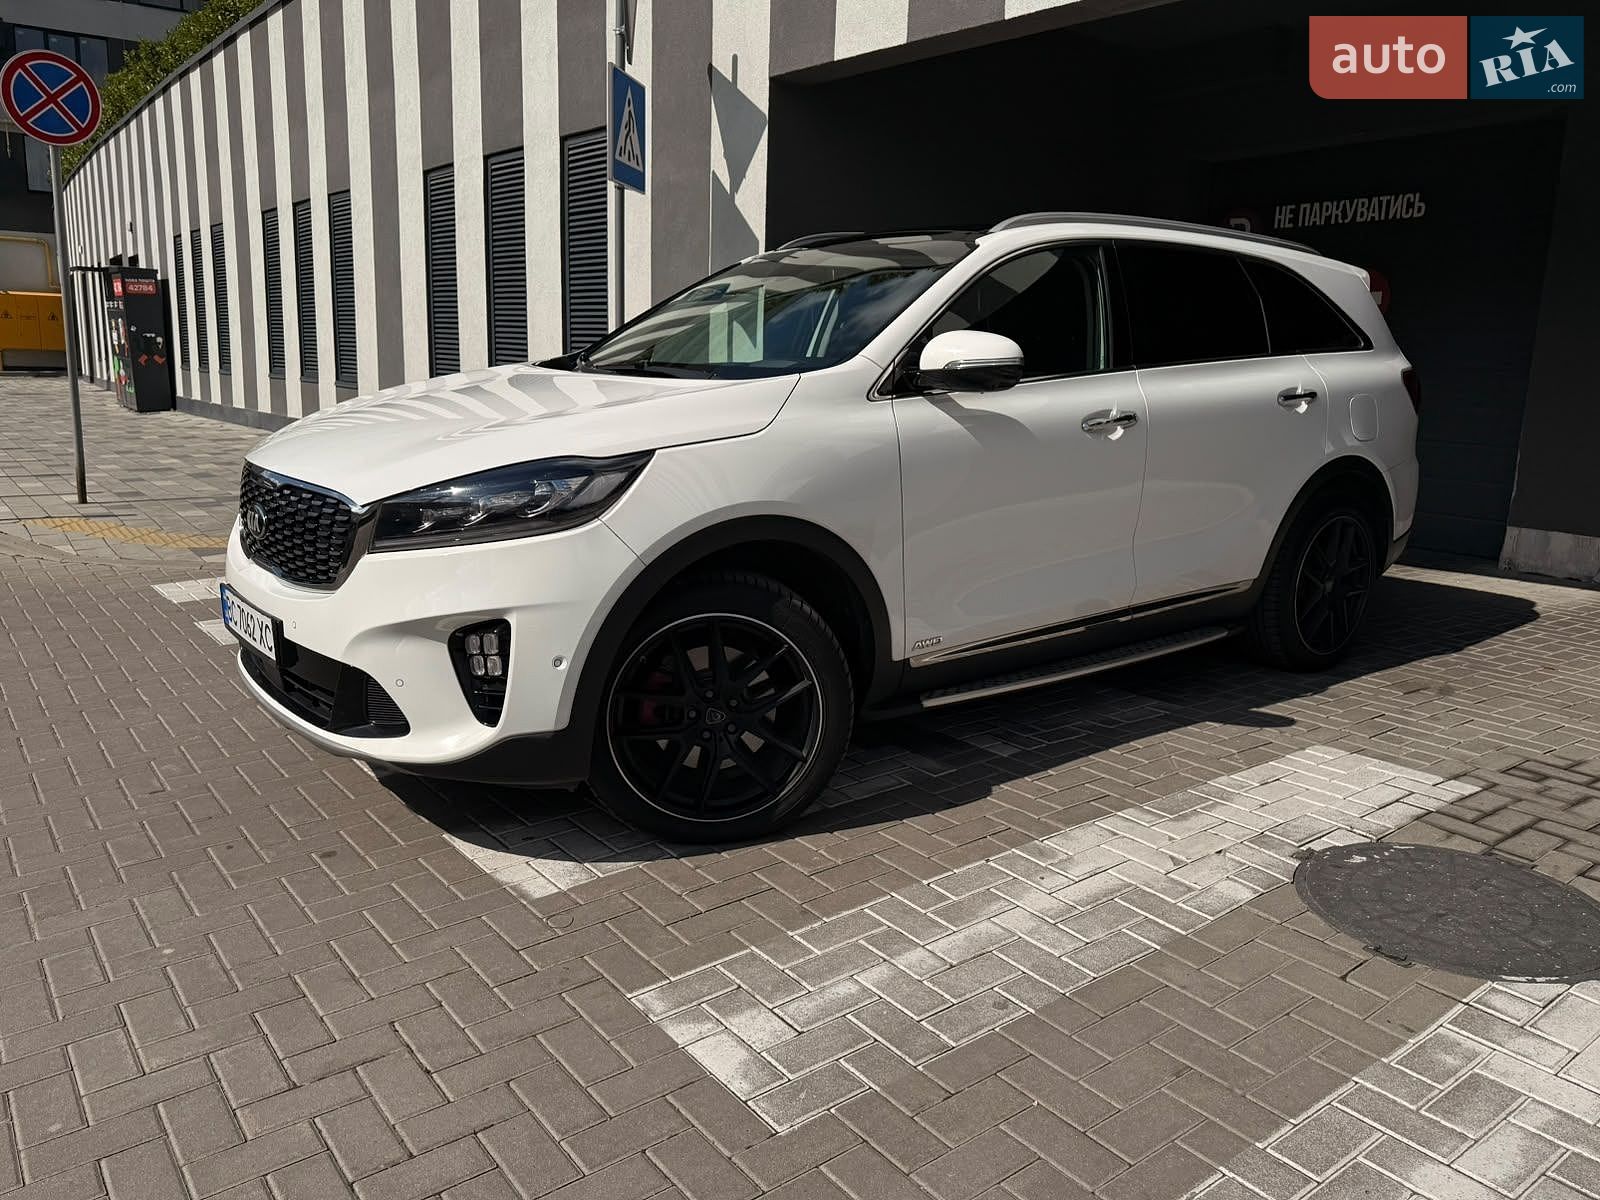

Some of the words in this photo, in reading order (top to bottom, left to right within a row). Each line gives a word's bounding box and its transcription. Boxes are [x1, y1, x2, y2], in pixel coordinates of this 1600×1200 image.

[1274, 205, 1296, 229] НЕ
[1299, 192, 1426, 227] ПАРКУВАТИСЬ
[257, 616, 273, 652] XC
[912, 635, 943, 650] AWD
